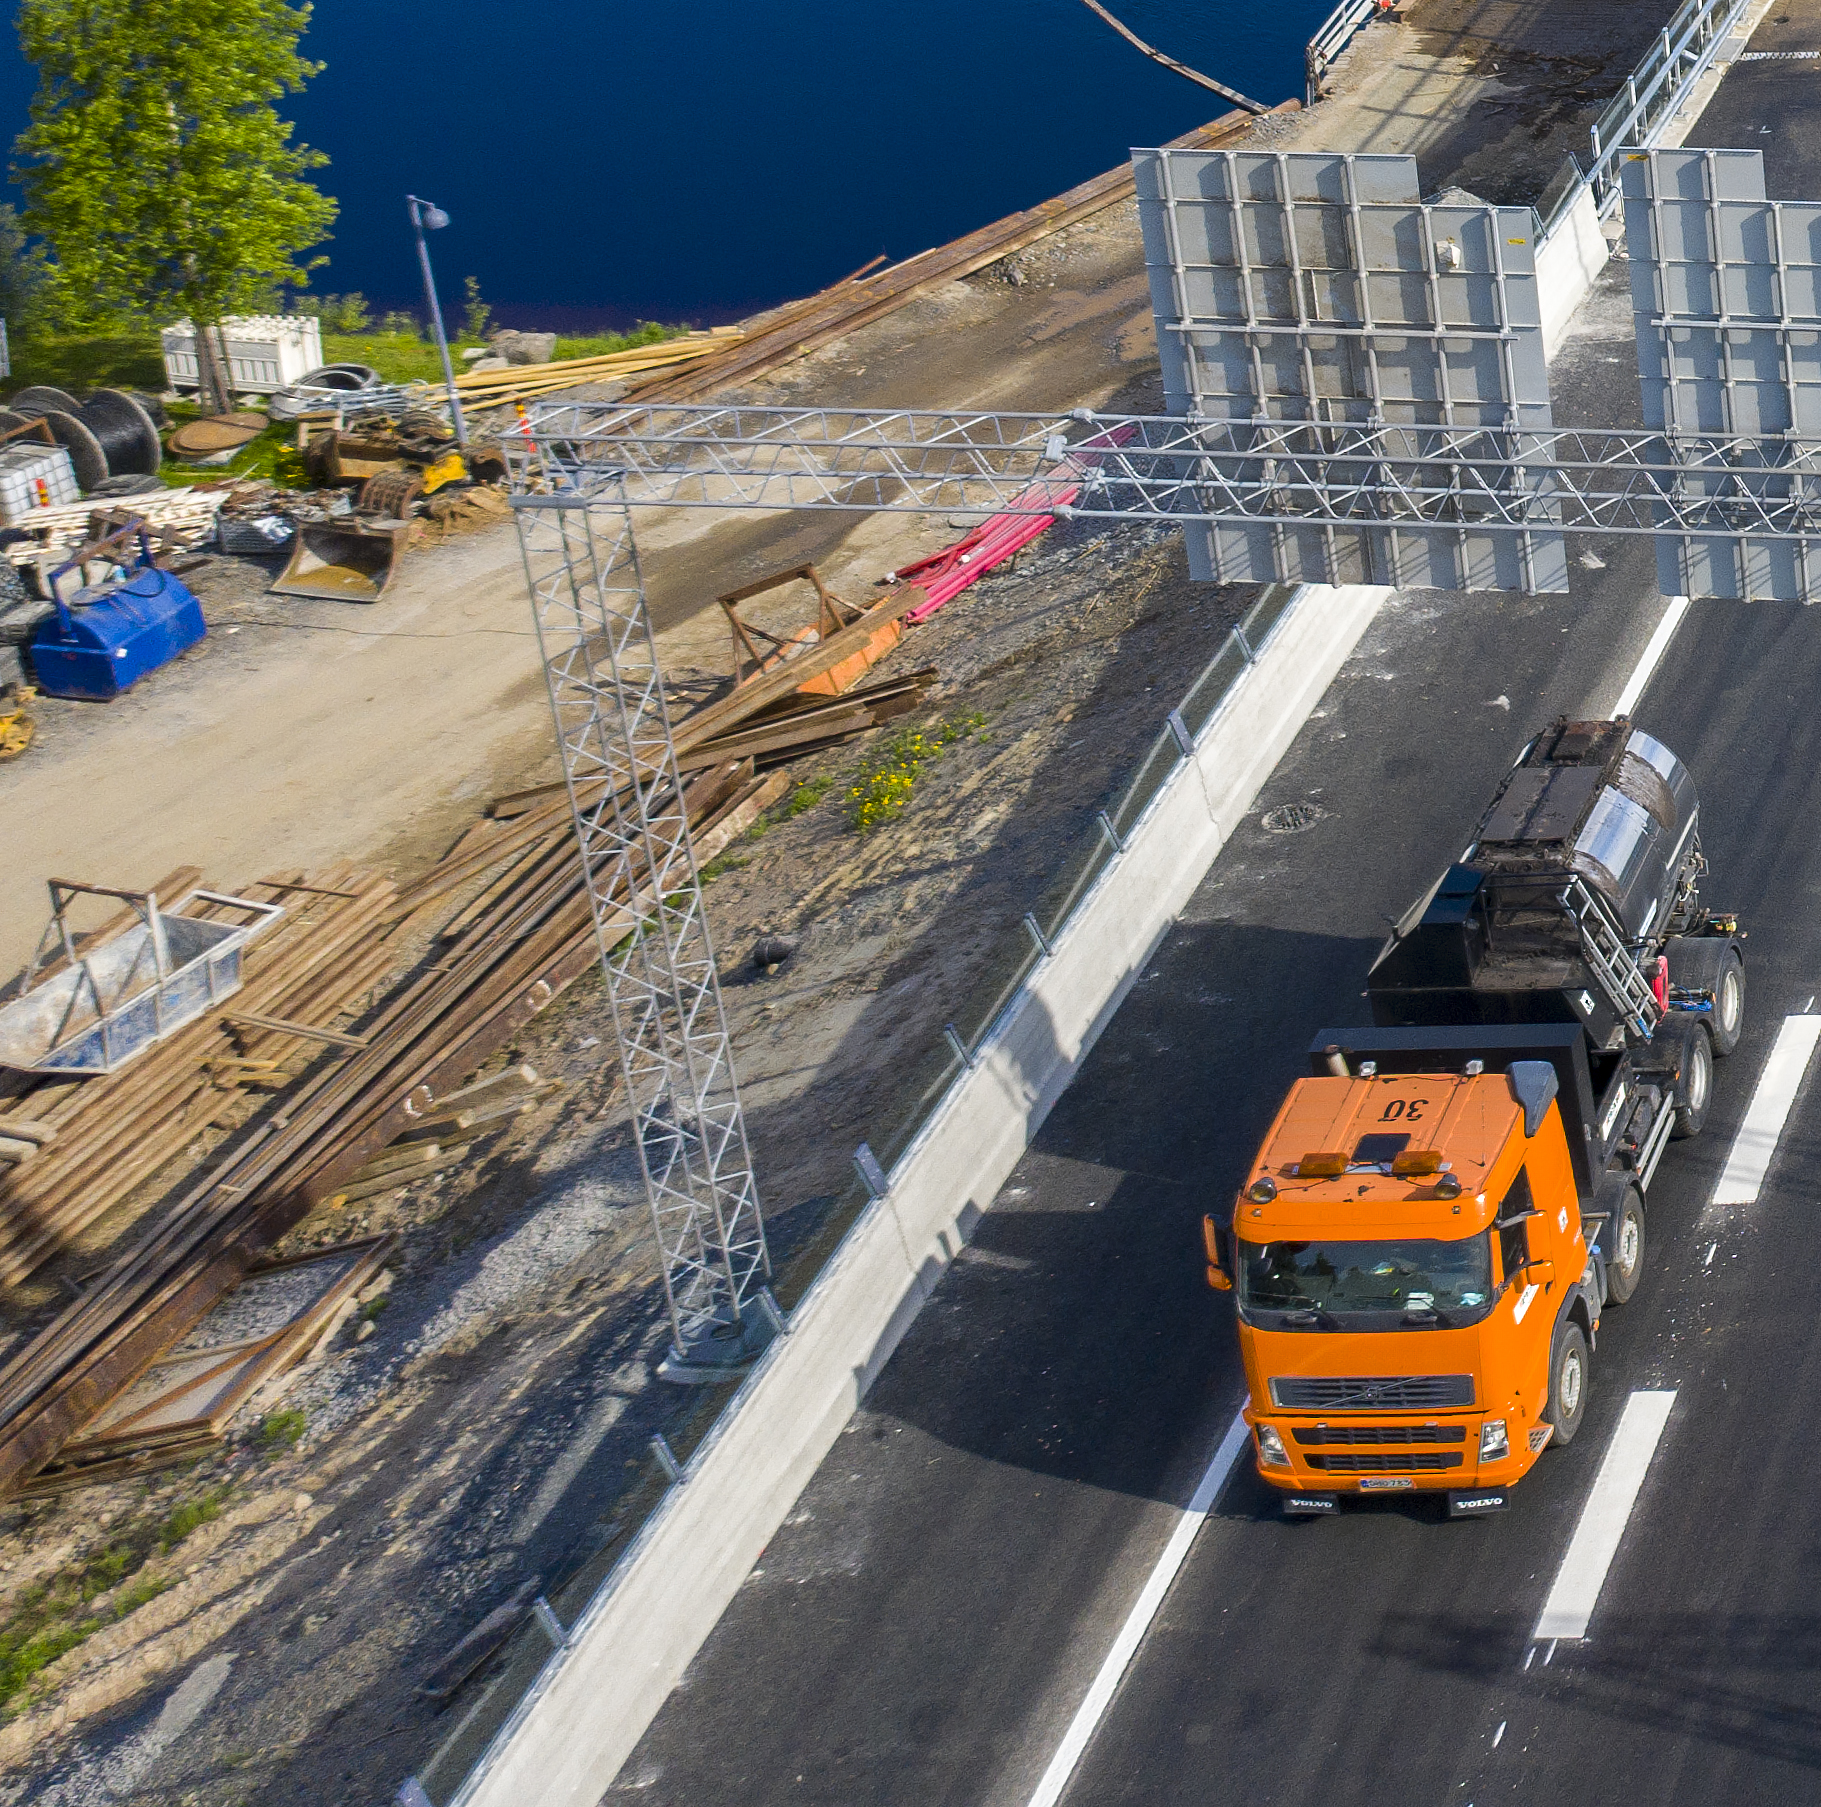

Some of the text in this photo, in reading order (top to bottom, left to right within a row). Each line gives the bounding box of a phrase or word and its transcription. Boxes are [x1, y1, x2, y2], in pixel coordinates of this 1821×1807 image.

[1378, 1099, 1429, 1122] 30
[1290, 1499, 1333, 1508] VOLVO
[1456, 1497, 1503, 1509] VOLVO
